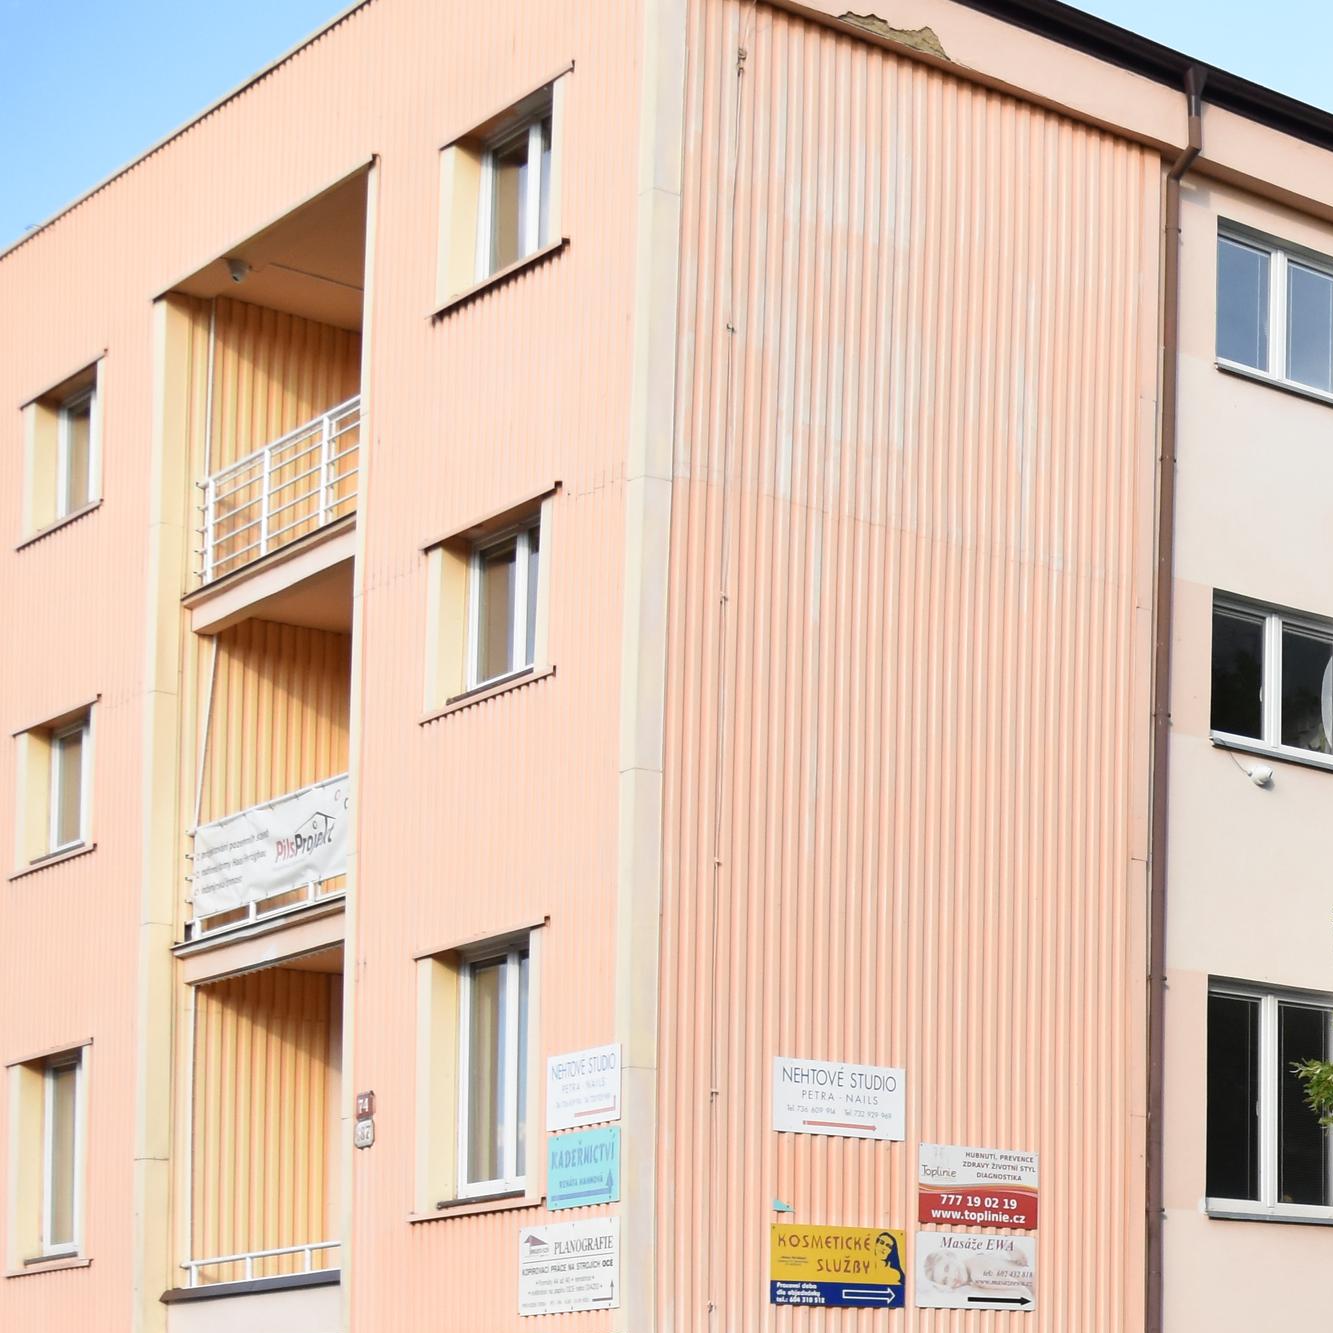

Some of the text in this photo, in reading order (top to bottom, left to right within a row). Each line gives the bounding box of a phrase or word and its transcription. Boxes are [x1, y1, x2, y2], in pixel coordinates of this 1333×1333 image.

[588, 1053, 616, 1074] STUDIO
[782, 1066, 897, 1092] NEHTOVÉ STUDIO
[802, 1090, 879, 1105] PETRA NAILS
[551, 1133, 615, 1170] KADEŘNICTVÍ
[1000, 1154, 1034, 1163] PREVENCE
[921, 1164, 957, 1178] Toplinie
[976, 1172, 1022, 1181] DIAGNOSTIKA
[940, 1194, 1017, 1209] 777 19 02 19
[931, 1208, 1026, 1224] www.toplinie.cz
[554, 1235, 614, 1255] PLANOGRAFIE
[778, 1233, 871, 1251] KOSMETICKÉ
[940, 1236, 1014, 1251] Masáže EWA
[817, 1256, 870, 1274] SLUŽBY
